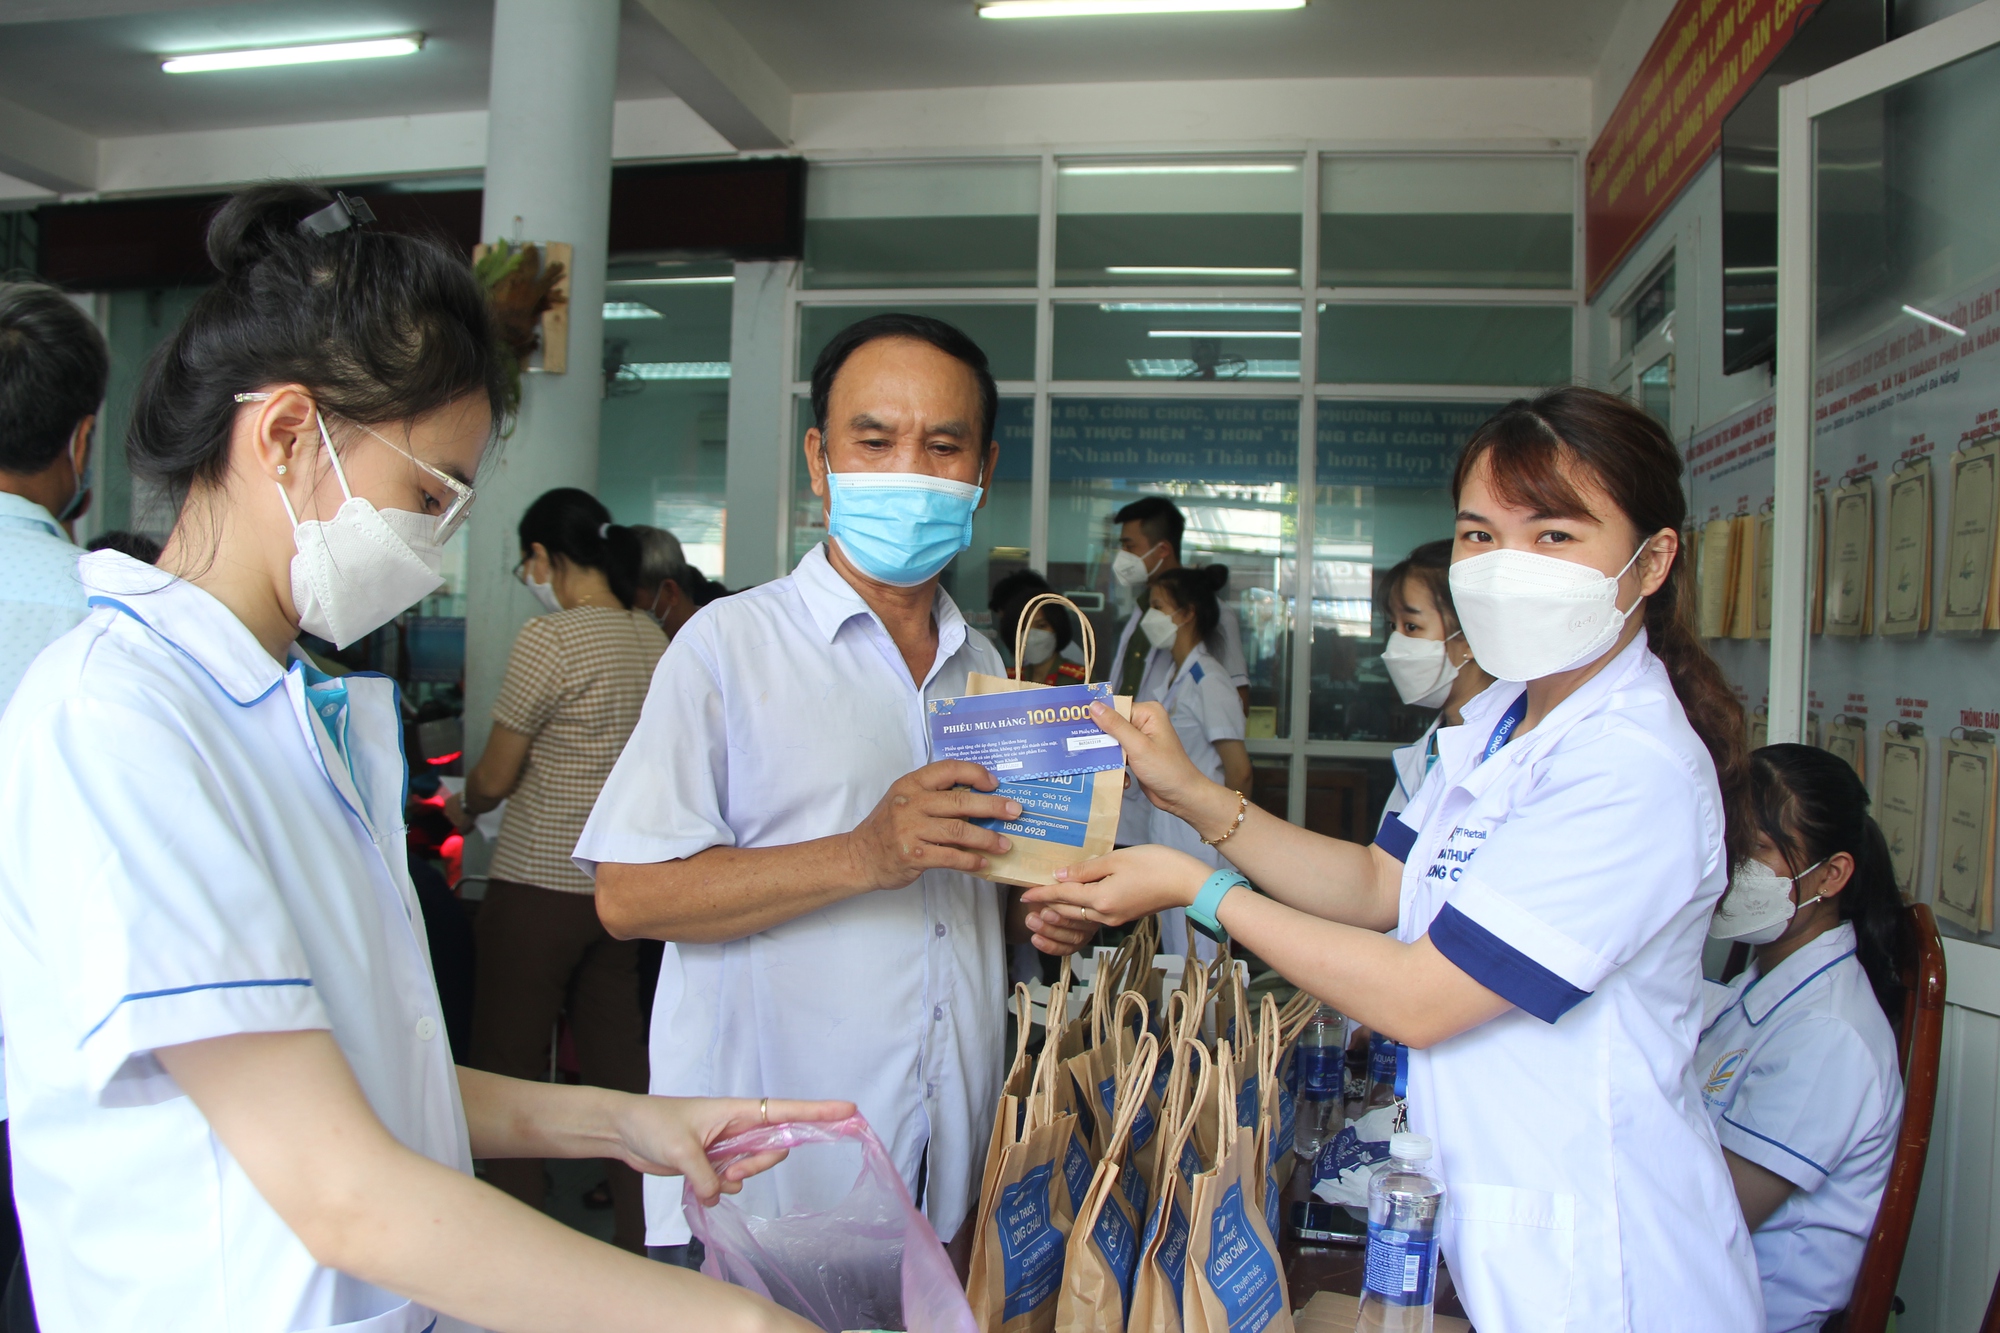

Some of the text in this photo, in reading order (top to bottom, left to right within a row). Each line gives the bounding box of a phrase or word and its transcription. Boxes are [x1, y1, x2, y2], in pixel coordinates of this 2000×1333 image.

[1709, 6, 1735, 65] LÀM
[1705, 54, 1738, 120] NHÂN
[1742, 11, 1770, 75] DÂN
[1971, 292, 1992, 324] LIÊN
[1908, 355, 1938, 380] THÀNH
[1939, 340, 1959, 367] PHỐ
[1960, 337, 1974, 358] ĐÀ
[1977, 325, 2000, 350] NẴN
[1065, 405, 1094, 420] BỘ,
[1100, 405, 1150, 419] CÔNG
[1155, 405, 1209, 421] CHỨC,
[1215, 405, 1256, 421] VIÊN
[1317, 409, 1392, 424] PHƯỜNG
[1084, 425, 1133, 442] THỰC
[1139, 425, 1186, 442] HIỆN
[1352, 429, 1386, 444] CẢI
[1392, 430, 1446, 445] CÁCH
[1146, 448, 1195, 465] hơn;
[1203, 448, 1259, 465] Thân
[1327, 451, 1377, 470] hơn;
[1385, 452, 1433, 474] Hợp
[943, 722, 973, 734] PHIẾU
[974, 719, 997, 731] MUA
[998, 716, 1027, 728] HÀNG
[1500, 716, 1516, 735] CHÂU
[1960, 707, 2000, 730] THÔNG BÁO
[1013, 795, 1069, 812] Hàng Tận Nơi
[1018, 789, 1032, 797] Tốt
[1042, 792, 1056, 800] Giá
[1058, 795, 1072, 803] Tốt
[1003, 821, 1046, 837] 1800 6928
[1464, 828, 1487, 840] Retail
[1009, 1201, 1037, 1226] NHÀ THUỐC
[1011, 1214, 1042, 1246] LONG CHÂU
[1022, 1240, 1053, 1268] Chuyên thuốc
[1164, 1227, 1188, 1267] LONG CHÂU
[1213, 1236, 1248, 1276] LONG CHÂU
[1232, 1263, 1262, 1294] Chuyên thuốc
[1238, 1294, 1249, 1307] theo
